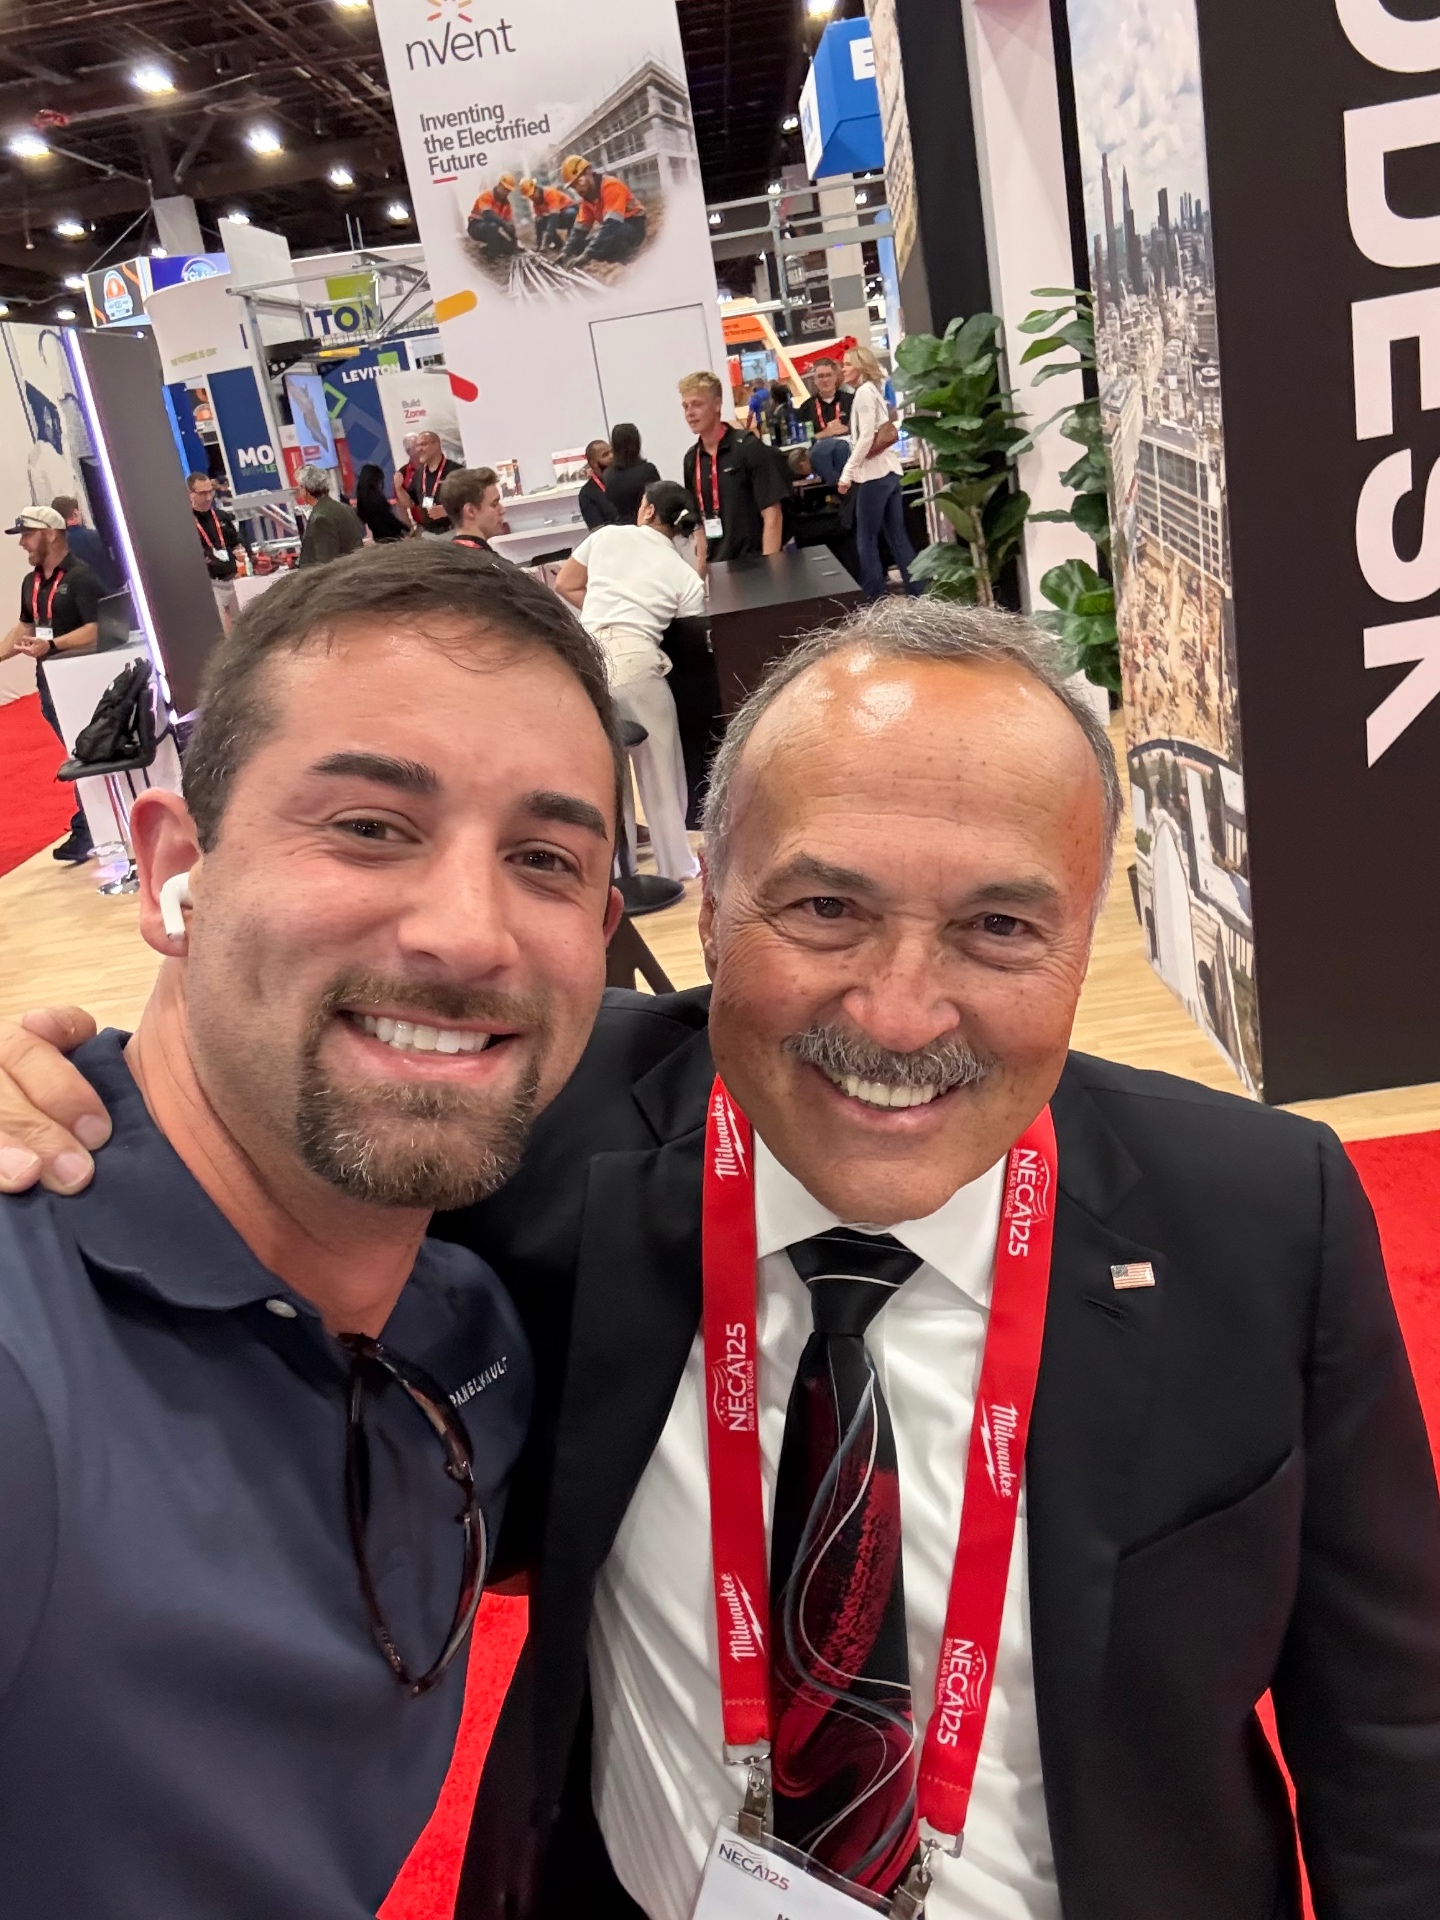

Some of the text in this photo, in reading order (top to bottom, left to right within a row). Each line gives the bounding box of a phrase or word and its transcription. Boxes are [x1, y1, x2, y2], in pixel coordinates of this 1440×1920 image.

[405, 18, 516, 70] nVent
[420, 103, 505, 133] Inventing
[423, 113, 551, 154] the Electrified
[428, 152, 488, 176] Future
[342, 362, 401, 384] LEVITON
[404, 409, 427, 418] Zone
[711, 1093, 739, 1181] Milwaukee
[1009, 1170, 1018, 1187] LAS
[1008, 1148, 1038, 1257] NECA125
[726, 1322, 748, 1431] NECA125
[746, 1360, 754, 1390] VEGAS
[990, 1402, 1019, 1498] Milwaukee
[720, 1572, 758, 1663] Milwaukee
[940, 1659, 950, 1676] LAS
[937, 1638, 974, 1747] NECA125
[718, 1843, 790, 1891] NECA125
